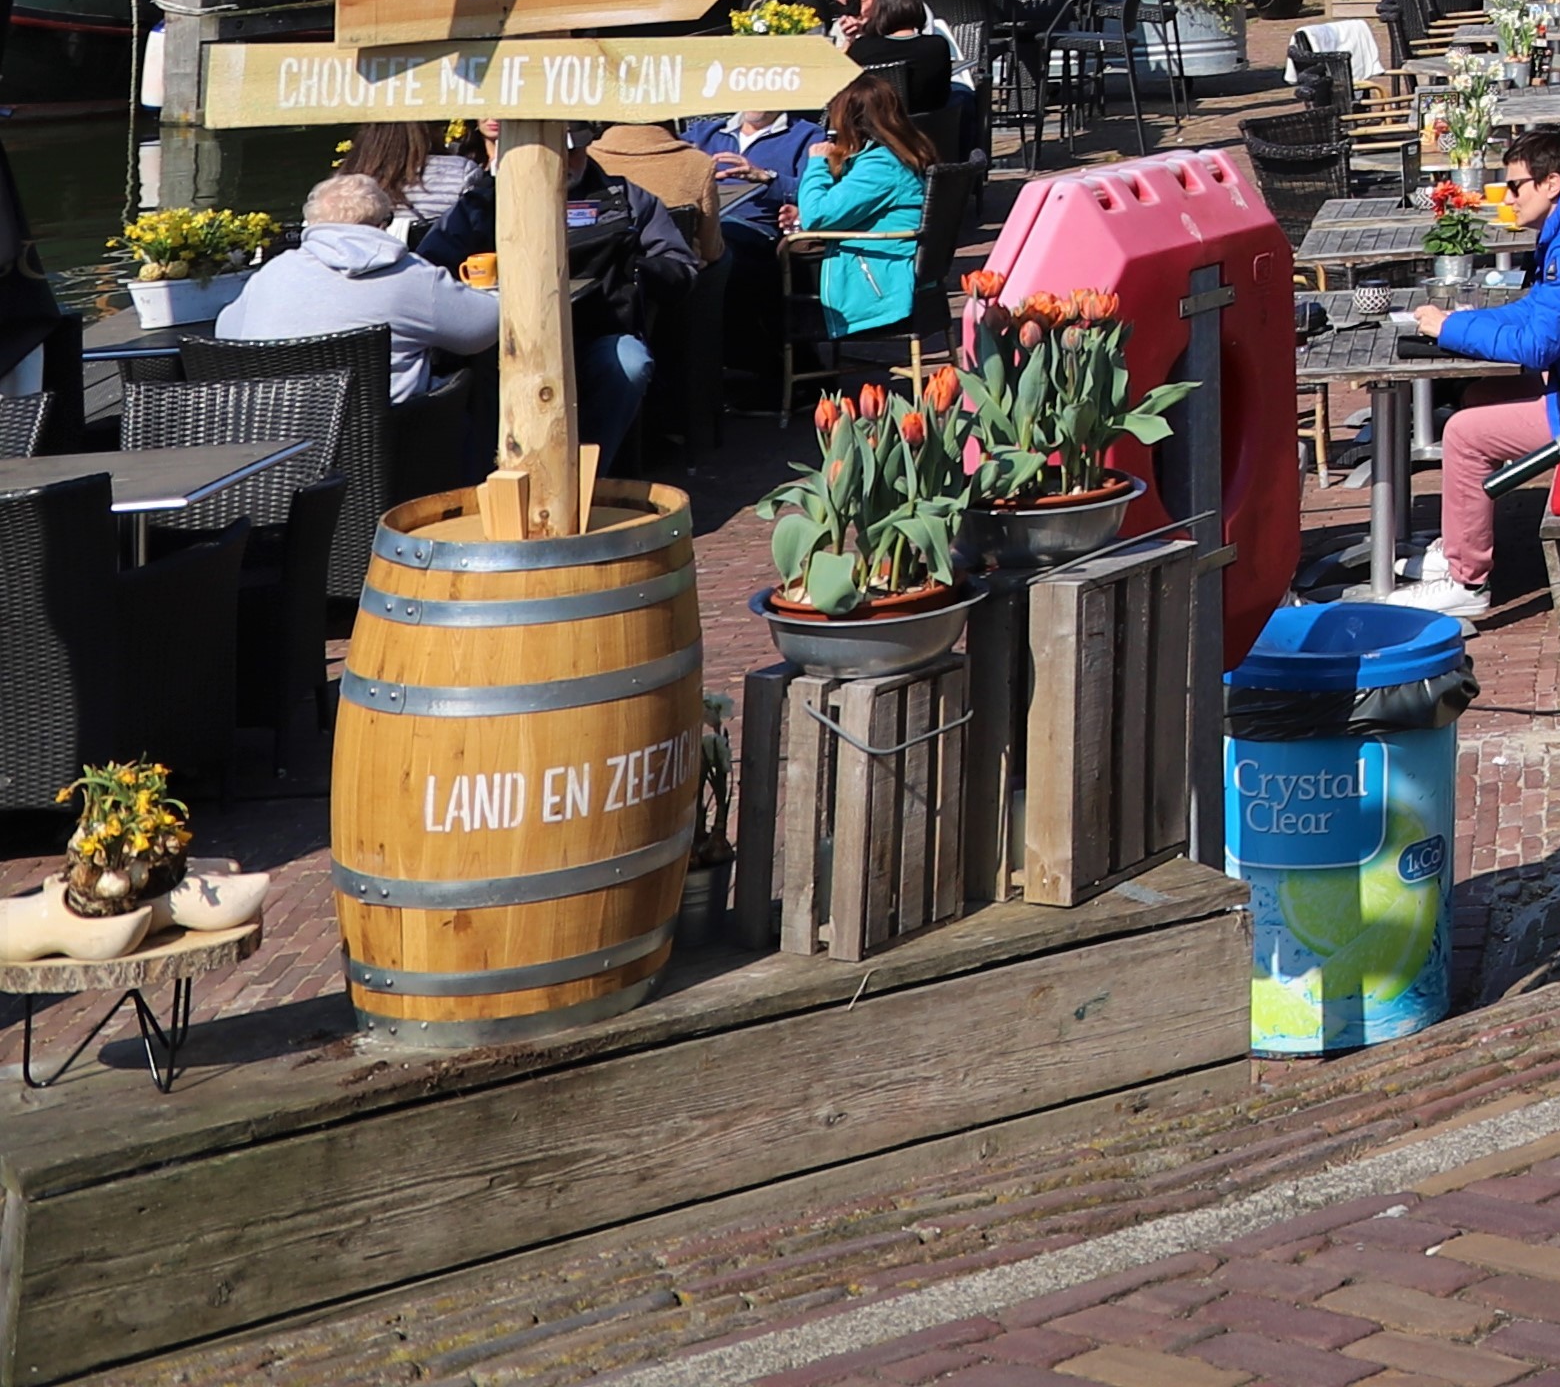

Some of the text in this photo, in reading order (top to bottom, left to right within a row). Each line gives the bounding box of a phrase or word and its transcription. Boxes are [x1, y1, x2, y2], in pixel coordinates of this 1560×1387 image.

[279, 54, 801, 110] CHOUFFE ME IF YOU CAN 6666
[424, 727, 700, 833] LAND EN ZEEZICH
[1233, 758, 1369, 809] Crystal
[1246, 800, 1333, 835] Clear
